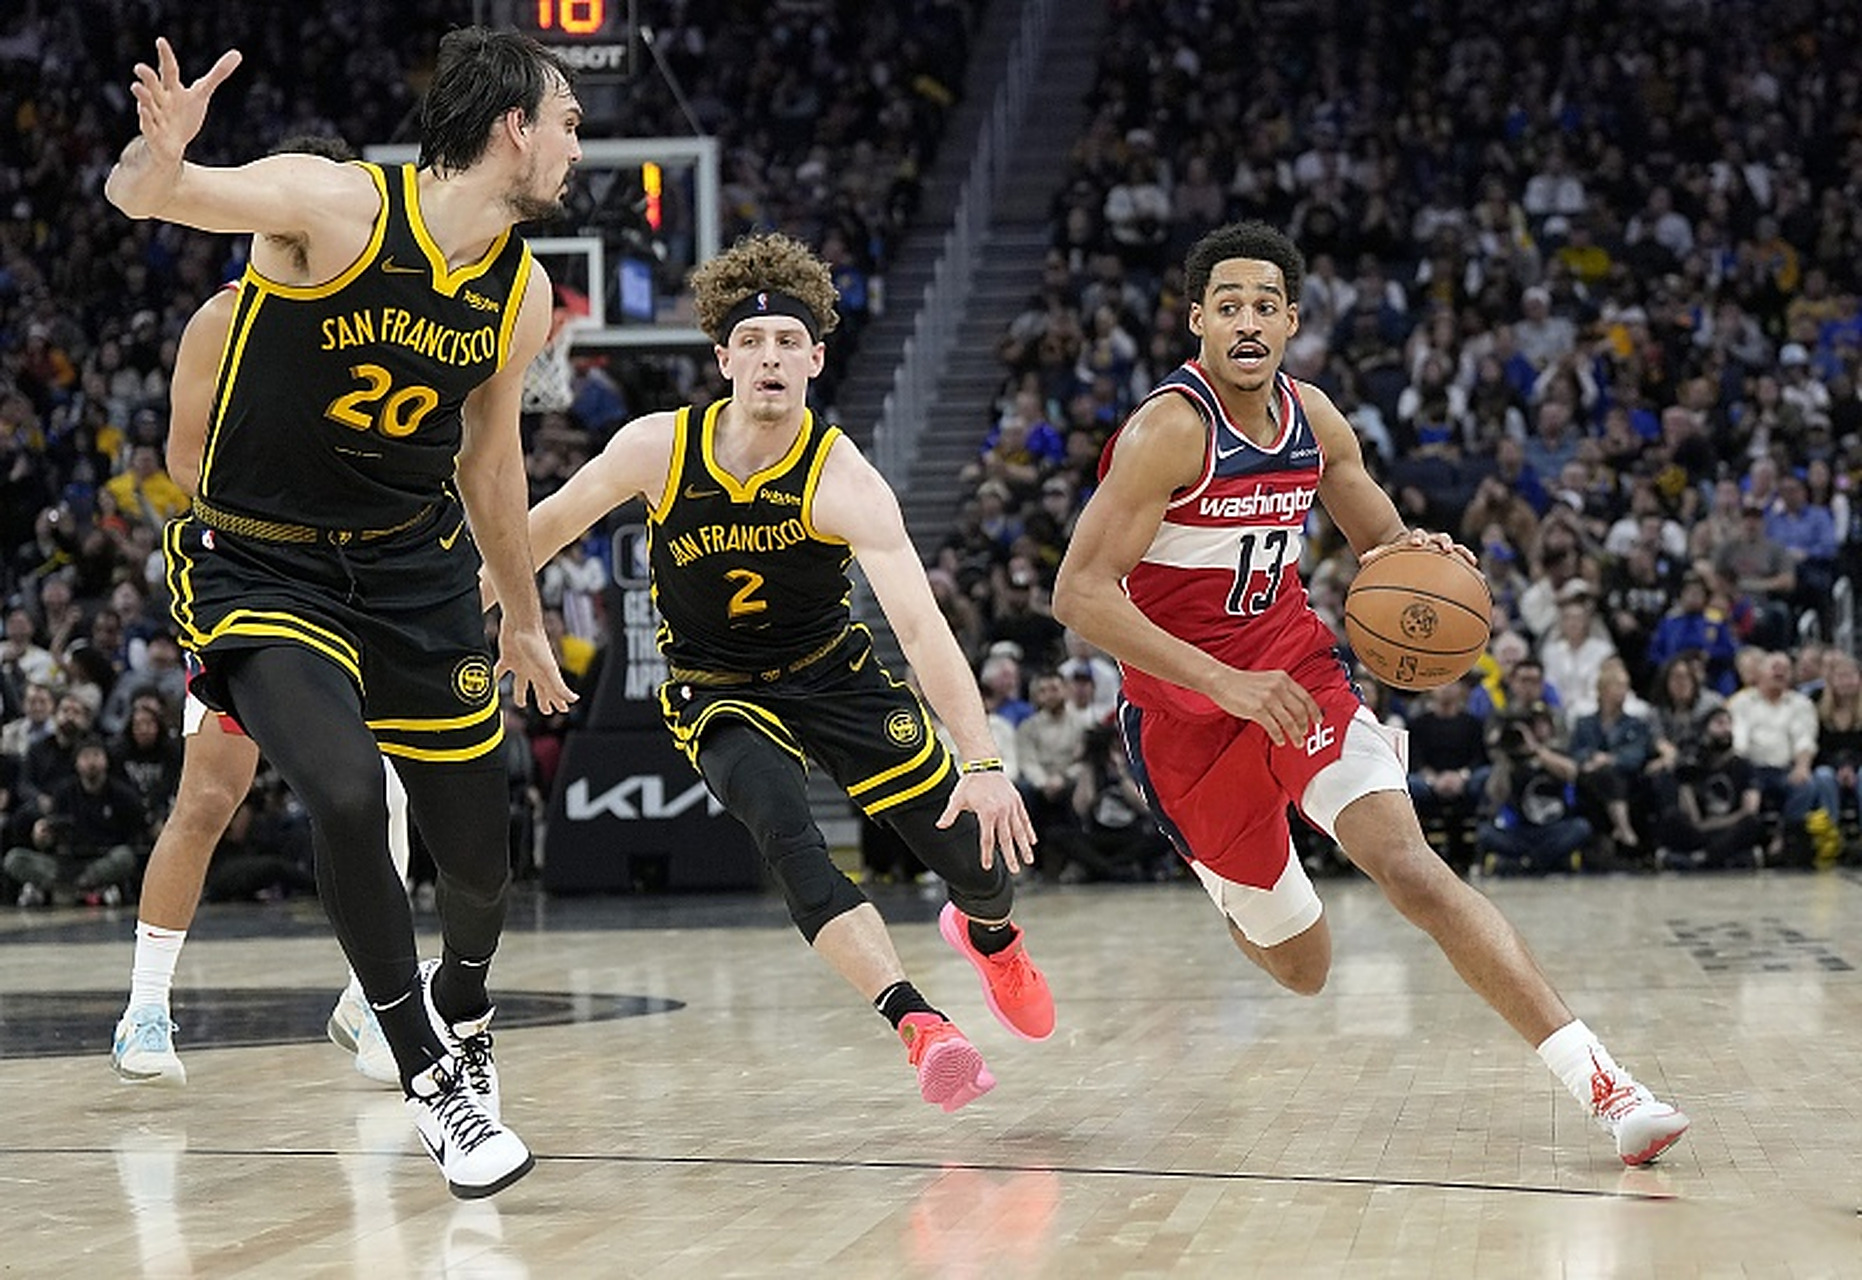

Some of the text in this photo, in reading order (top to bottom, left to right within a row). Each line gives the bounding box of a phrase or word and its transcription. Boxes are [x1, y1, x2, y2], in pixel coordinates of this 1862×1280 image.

[321, 308, 495, 366] SAN FRANCISCO
[324, 363, 439, 438] 20
[699, 518, 806, 554] FRANCISCO
[723, 568, 767, 617] 2
[1225, 529, 1289, 615] 13
[1307, 723, 1334, 756] dc
